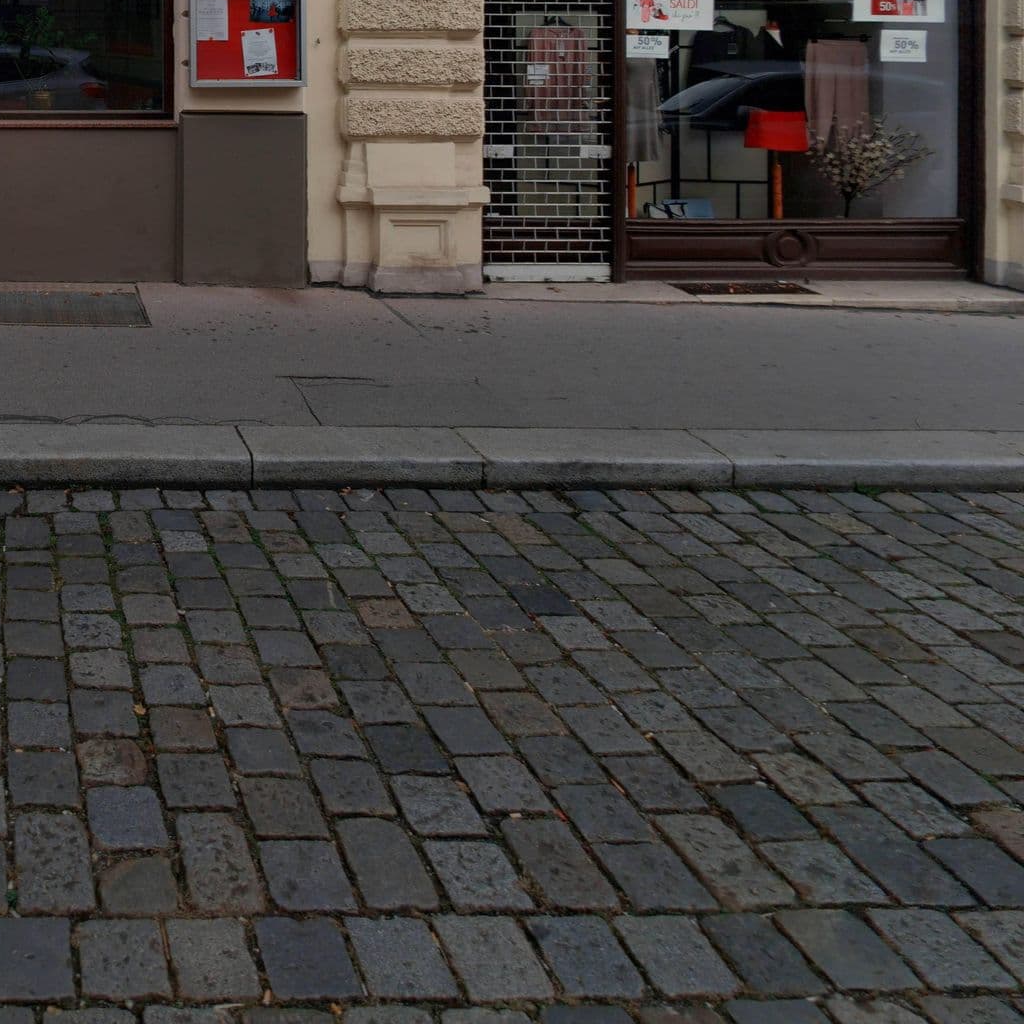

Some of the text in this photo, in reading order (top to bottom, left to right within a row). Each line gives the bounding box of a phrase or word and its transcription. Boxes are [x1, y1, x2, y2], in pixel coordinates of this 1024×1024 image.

[670, 0, 698, 8] SALDI
[637, 37, 663, 46] 50%
[894, 40, 919, 50] 50%
